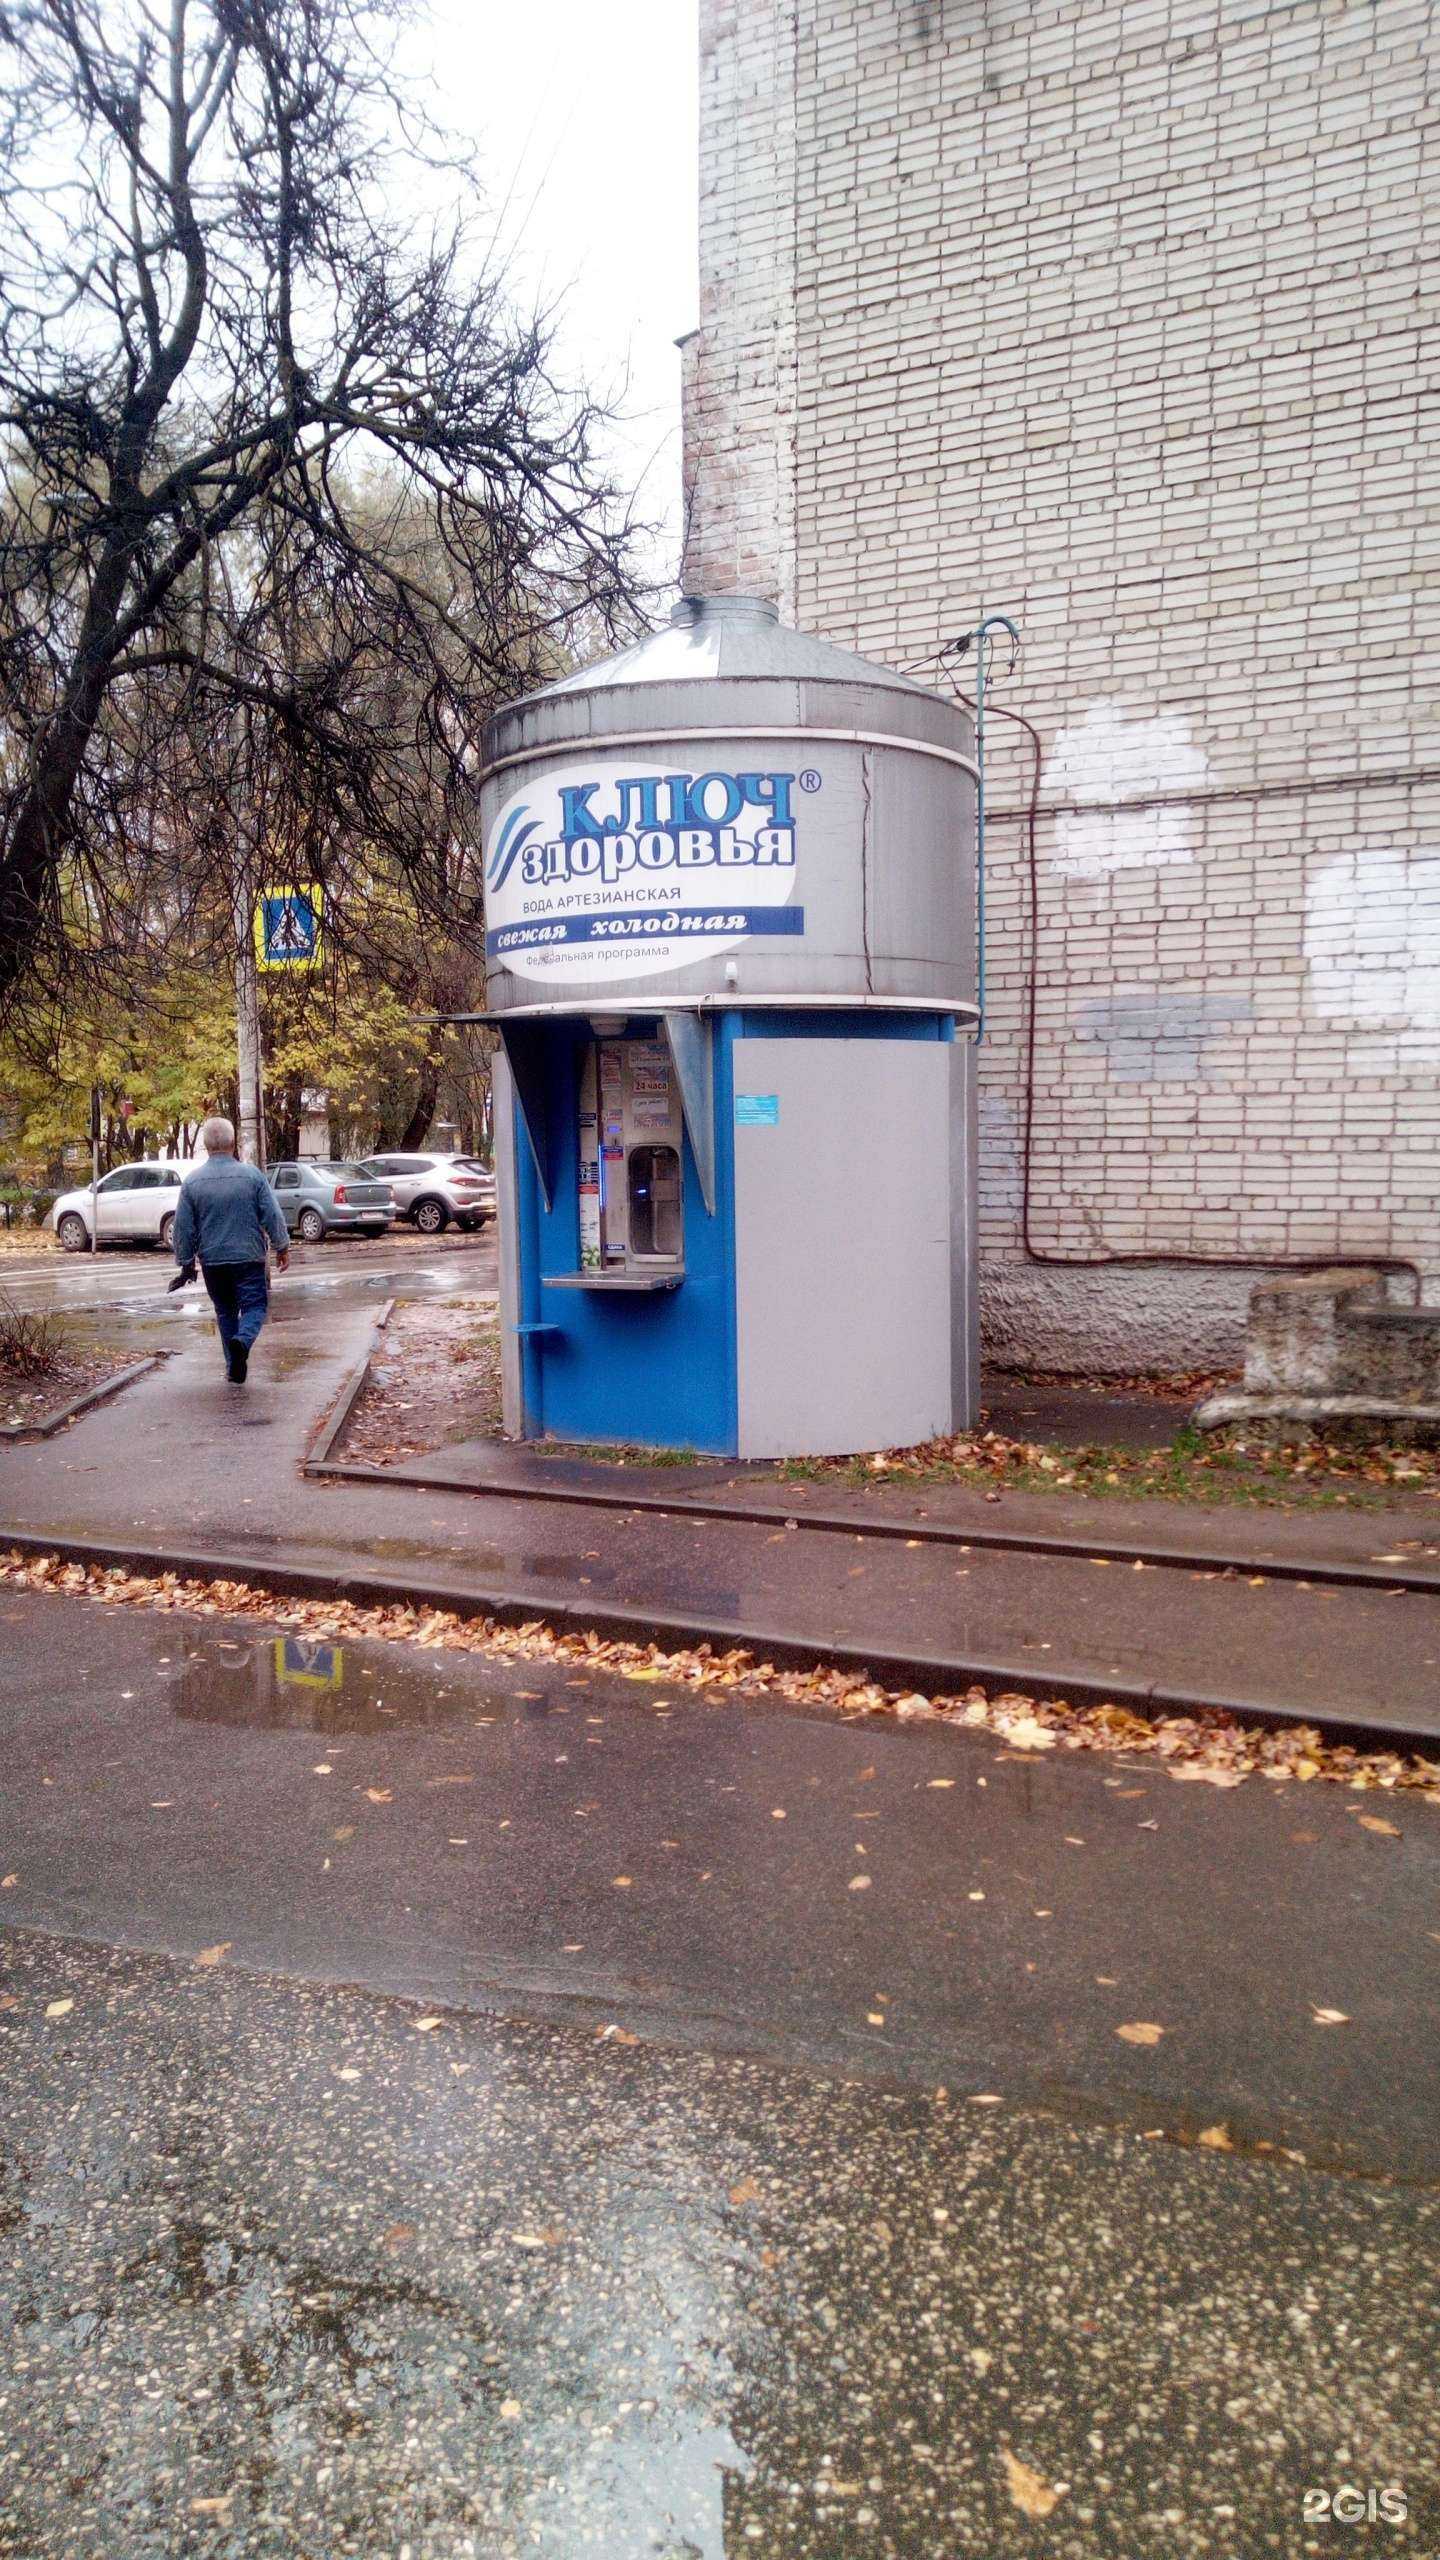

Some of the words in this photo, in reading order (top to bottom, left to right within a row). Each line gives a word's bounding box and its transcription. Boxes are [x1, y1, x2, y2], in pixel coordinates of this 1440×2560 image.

[558, 771, 796, 837] КЛЮЧ
[523, 900, 554, 914] ВОДА
[557, 887, 681, 907] АРТЕЗИАНСКАЯ
[497, 923, 568, 948] свежая
[590, 911, 748, 936] холодная
[597, 946, 670, 963] программа
